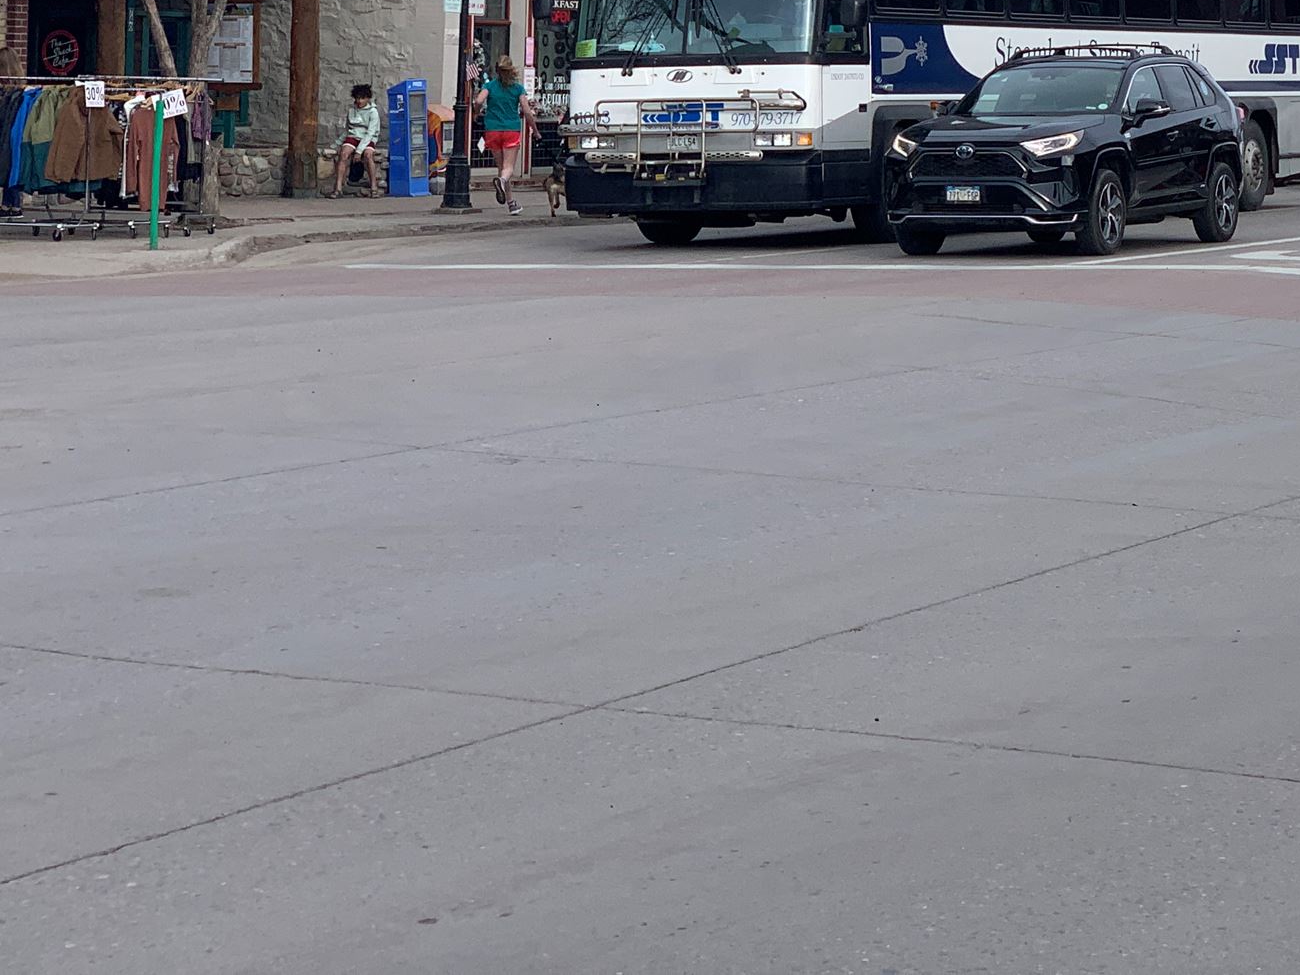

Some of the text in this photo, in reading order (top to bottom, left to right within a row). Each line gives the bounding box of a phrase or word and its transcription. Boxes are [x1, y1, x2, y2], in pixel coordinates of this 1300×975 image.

[1258, 43, 1300, 74] SST
[85, 87, 104, 101] 30%
[163, 95, 185, 110] 0%
